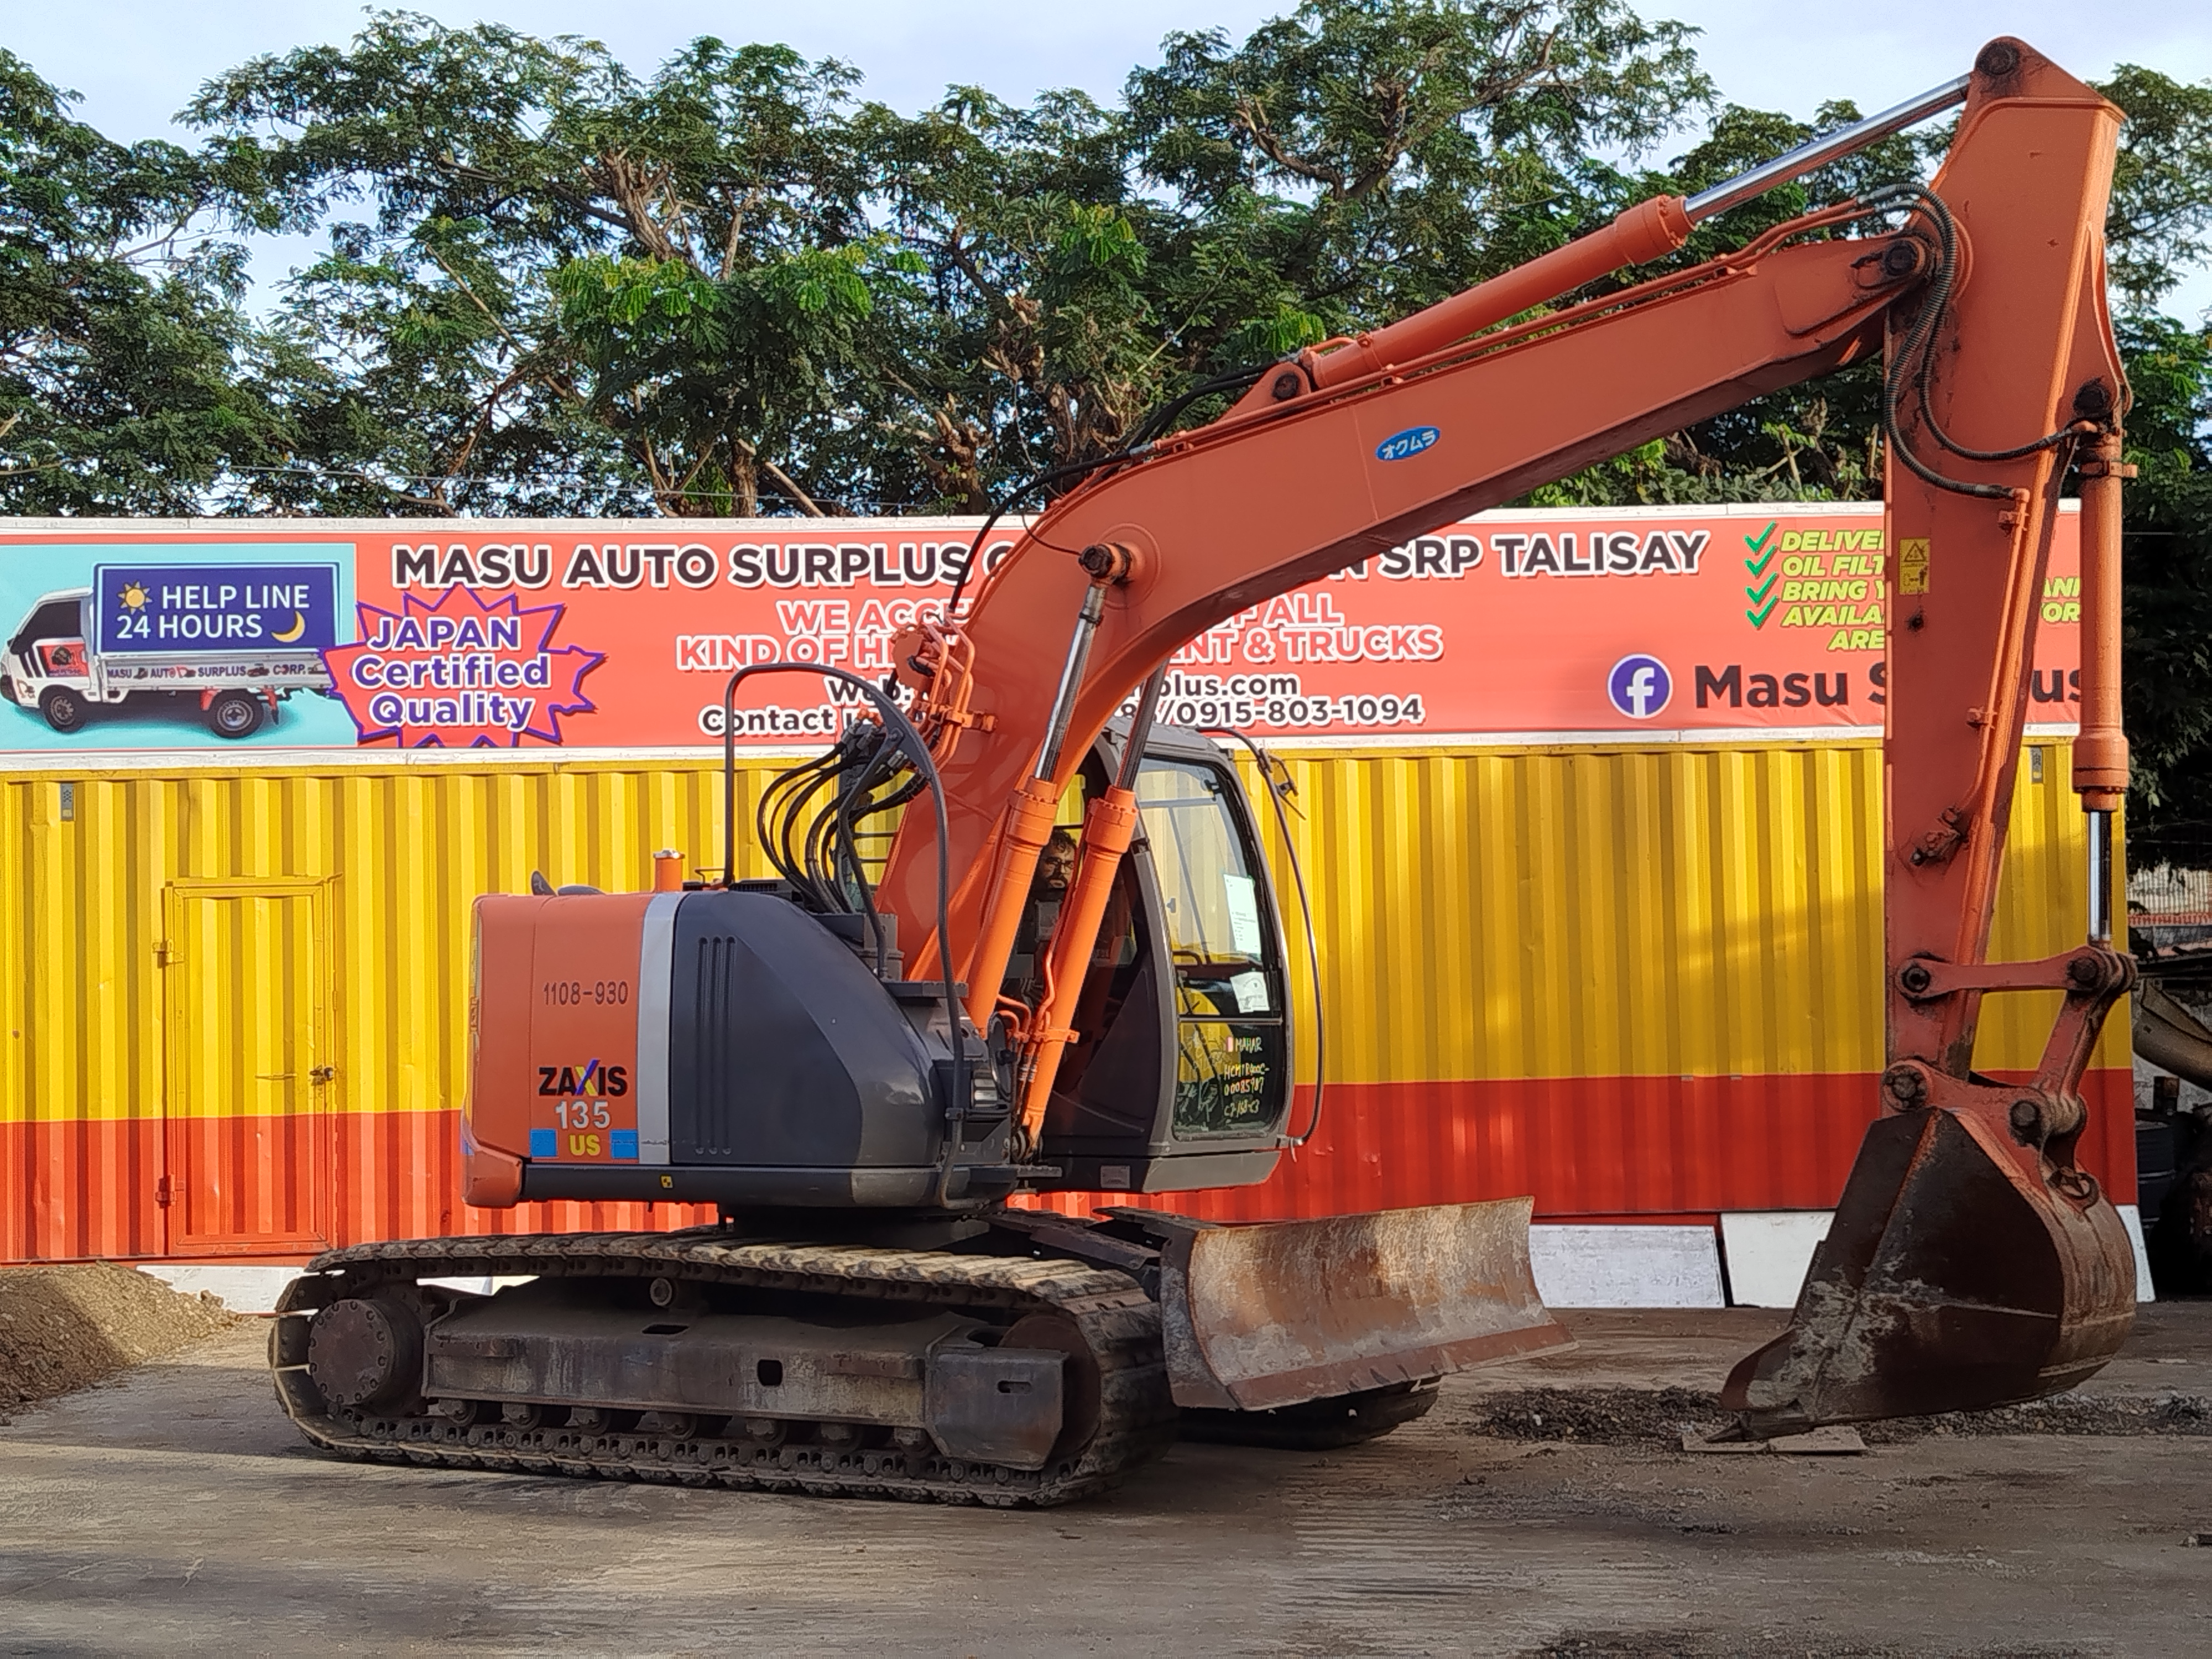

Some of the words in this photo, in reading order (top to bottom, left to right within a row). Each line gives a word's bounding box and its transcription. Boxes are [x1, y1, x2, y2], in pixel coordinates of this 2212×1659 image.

[1381, 430, 1436, 460] オクムラ
[395, 546, 550, 586] MASU
[565, 546, 717, 586] AUTO
[730, 545, 972, 586] SURPLUS
[1381, 535, 1480, 576] SRP
[1494, 533, 1709, 575] TALISAY
[1782, 555, 1827, 577] OIL
[1832, 555, 1885, 576] FILT
[163, 585, 237, 609] HELP
[246, 585, 310, 608] LINE
[1781, 581, 1868, 602] BRING
[117, 615, 151, 639] 24
[159, 614, 263, 639] HOURS
[777, 600, 849, 635] WE
[1264, 593, 1344, 628] ALL
[1780, 604, 1885, 627] AVAILA
[370, 616, 520, 650] JAPAN
[676, 635, 781, 670] KIND
[786, 634, 853, 667] OF
[1244, 627, 1276, 662] &
[1281, 624, 1444, 662] TRUCKS
[1827, 629, 1885, 651] ARE
[150, 667, 176, 678] AUTO
[198, 666, 246, 677] SURPLUS
[273, 664, 306, 676] CORP.
[354, 655, 550, 688] Certified
[1695, 665, 1848, 708] Masu
[371, 693, 534, 730] Quality
[701, 706, 834, 734] Contact
[544, 980, 629, 1006] 1108-930
[539, 1058, 628, 1096] ZAXIS
[555, 1100, 611, 1130] 135
[569, 1134, 601, 1156] US
